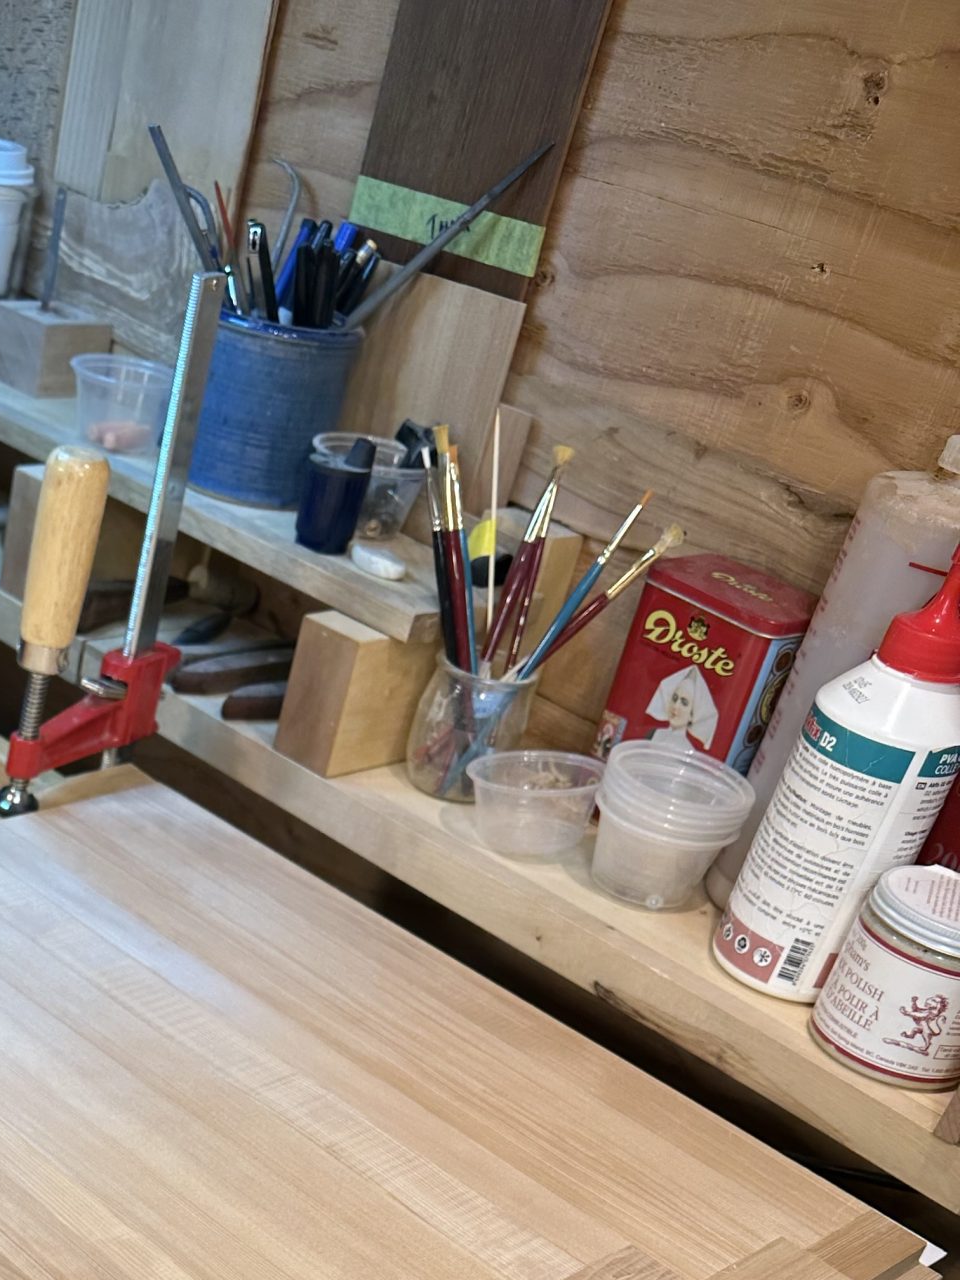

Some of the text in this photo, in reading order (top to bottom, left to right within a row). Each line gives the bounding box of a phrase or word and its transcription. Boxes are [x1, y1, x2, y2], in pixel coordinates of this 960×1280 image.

[643, 609, 736, 677] Droste
[820, 732, 837, 751] D2
[845, 968, 884, 1002] POLISH
[836, 985, 868, 1016] POLIR
[869, 1003, 880, 1022] À
